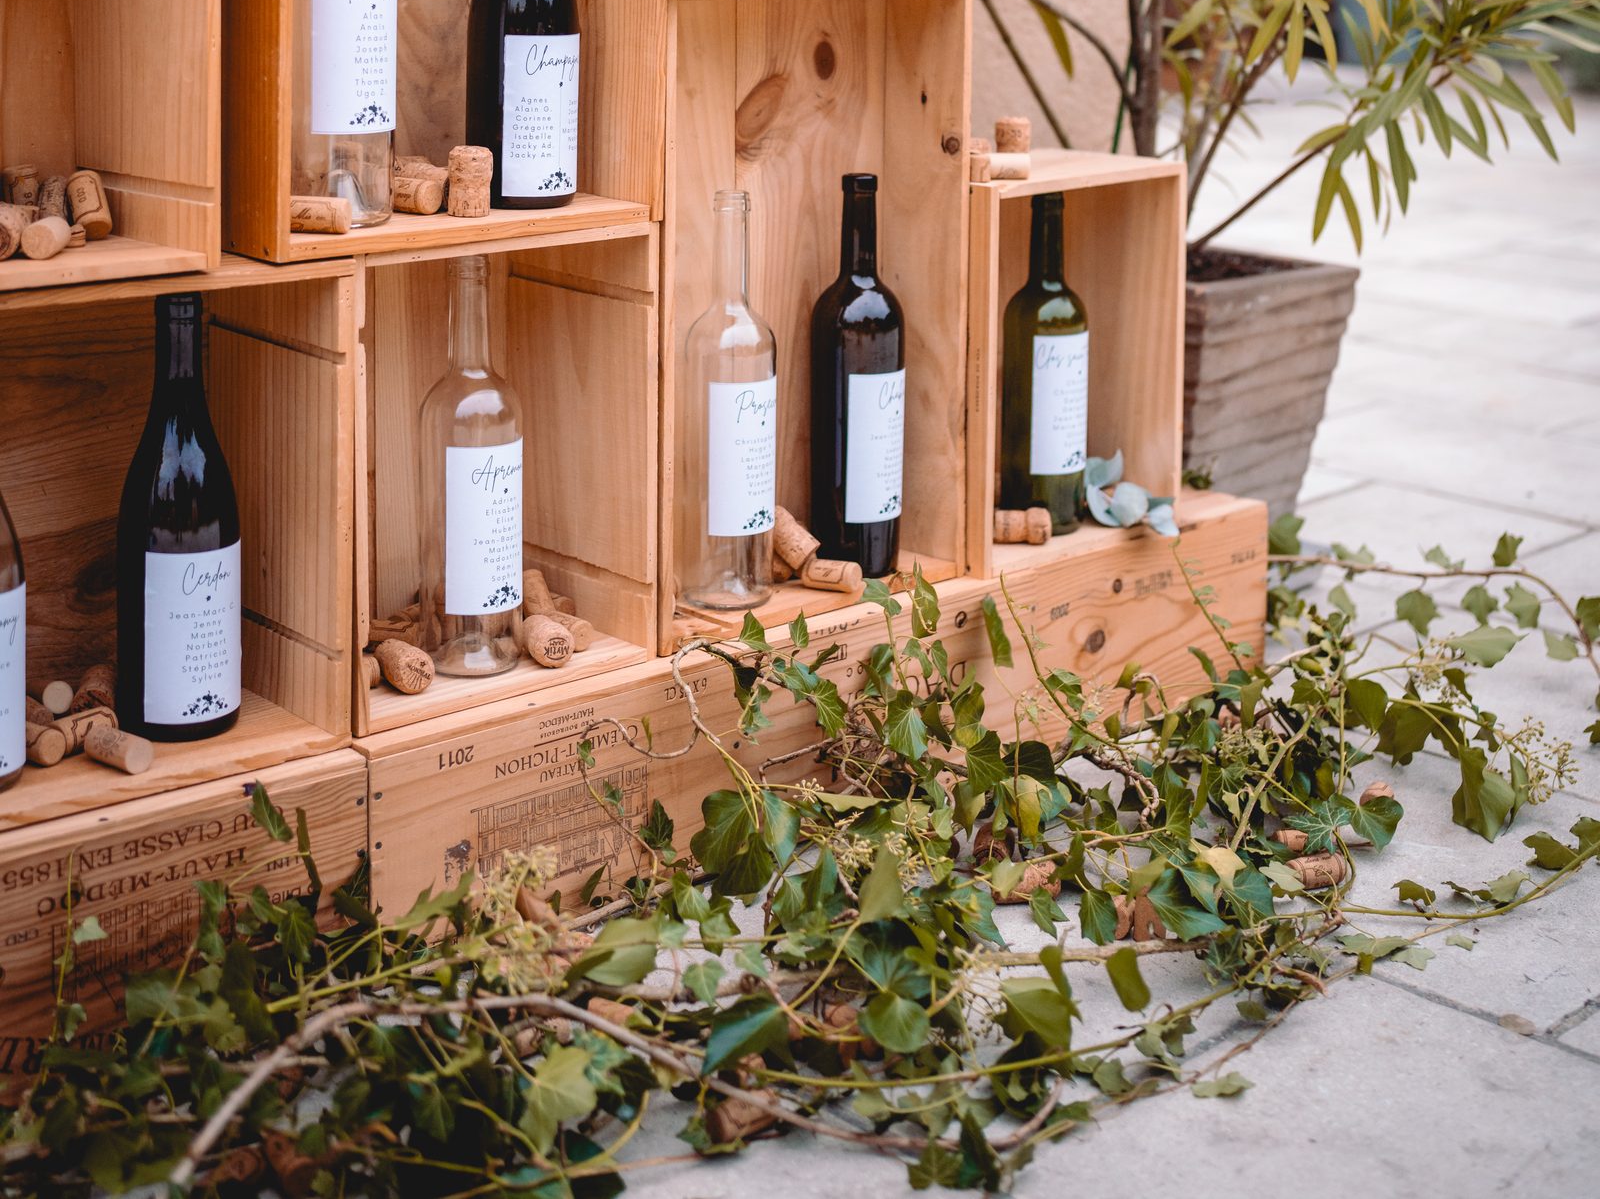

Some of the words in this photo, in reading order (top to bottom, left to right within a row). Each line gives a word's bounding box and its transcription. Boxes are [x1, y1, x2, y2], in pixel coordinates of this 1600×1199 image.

[515, 105, 539, 113] Alain
[516, 114, 552, 122] Corinne
[512, 123, 554, 133] Grégoire
[511, 142, 537, 151] Jacky
[510, 151, 537, 160] Jacky
[182, 560, 231, 596] Cerdon
[169, 607, 226, 620] Jean-Marc
[193, 619, 222, 630] Jenny
[190, 629, 224, 640] Mamie
[186, 638, 226, 651] Norbert
[185, 649, 227, 662] Patricia
[191, 672, 222, 684] Sylvie
[539, 707, 595, 730] HAUT-MÉDOC
[438, 744, 475, 771] 2011
[78, 845, 113, 873] EN
[2, 857, 66, 892] 1855
